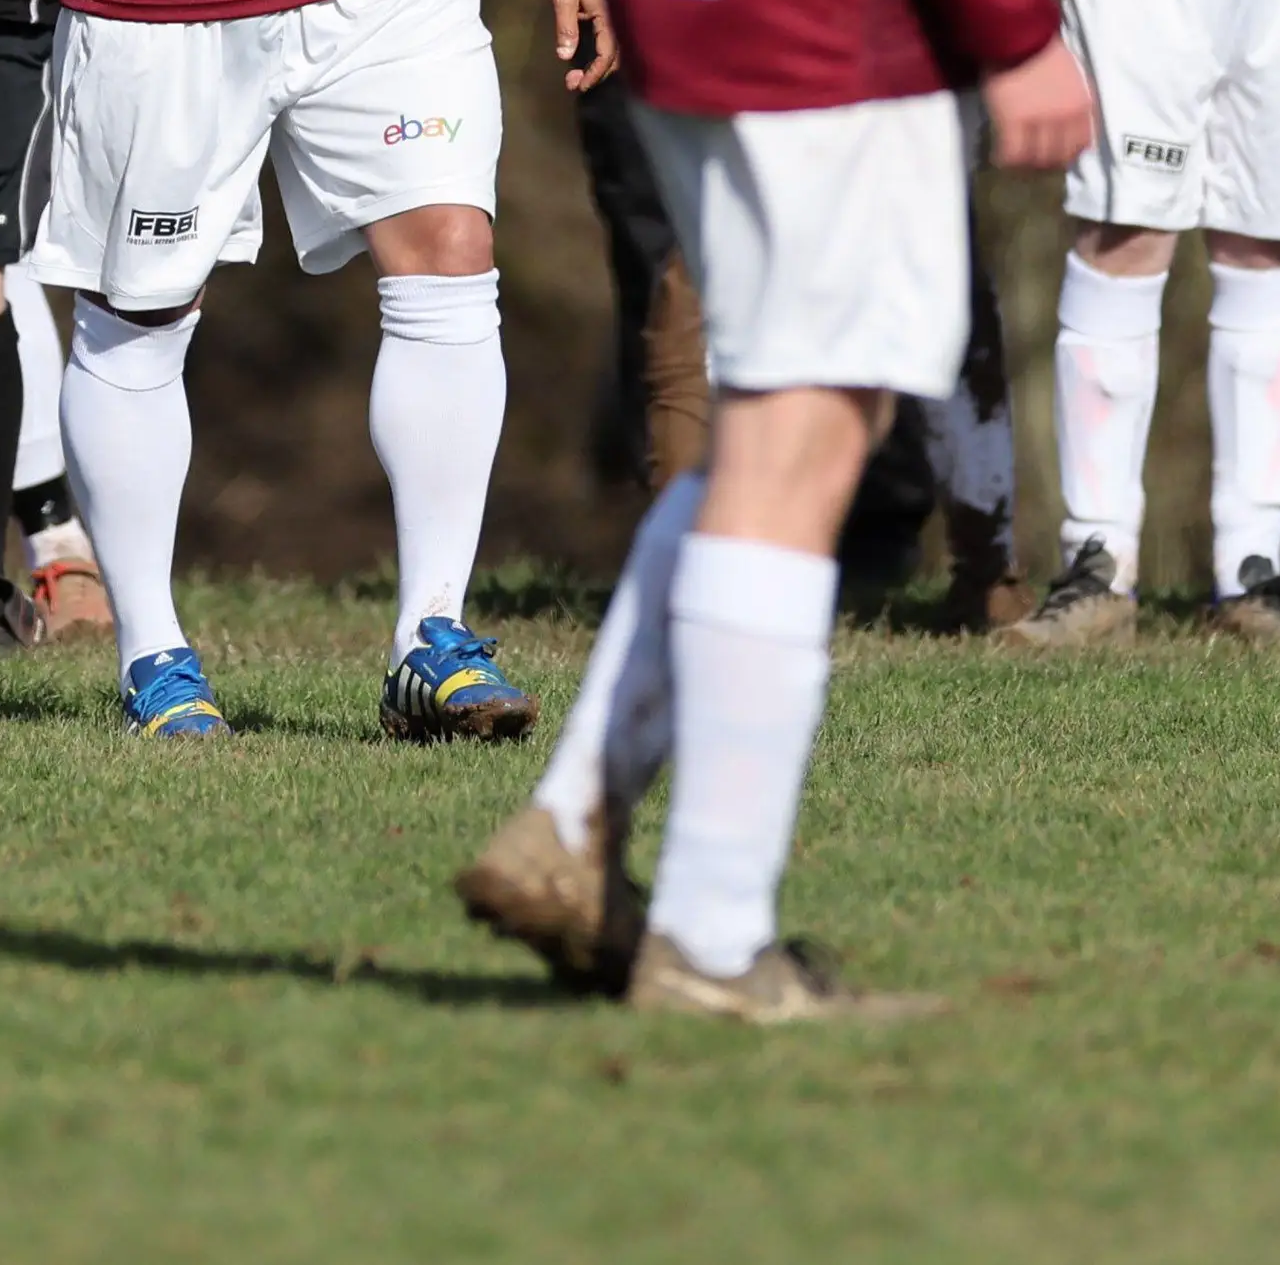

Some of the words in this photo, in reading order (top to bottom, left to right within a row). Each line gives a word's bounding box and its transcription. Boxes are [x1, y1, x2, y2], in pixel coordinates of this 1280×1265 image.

[384, 114, 463, 145] ebay
[1127, 139, 1179, 167] FBB
[134, 214, 194, 236] FBB
